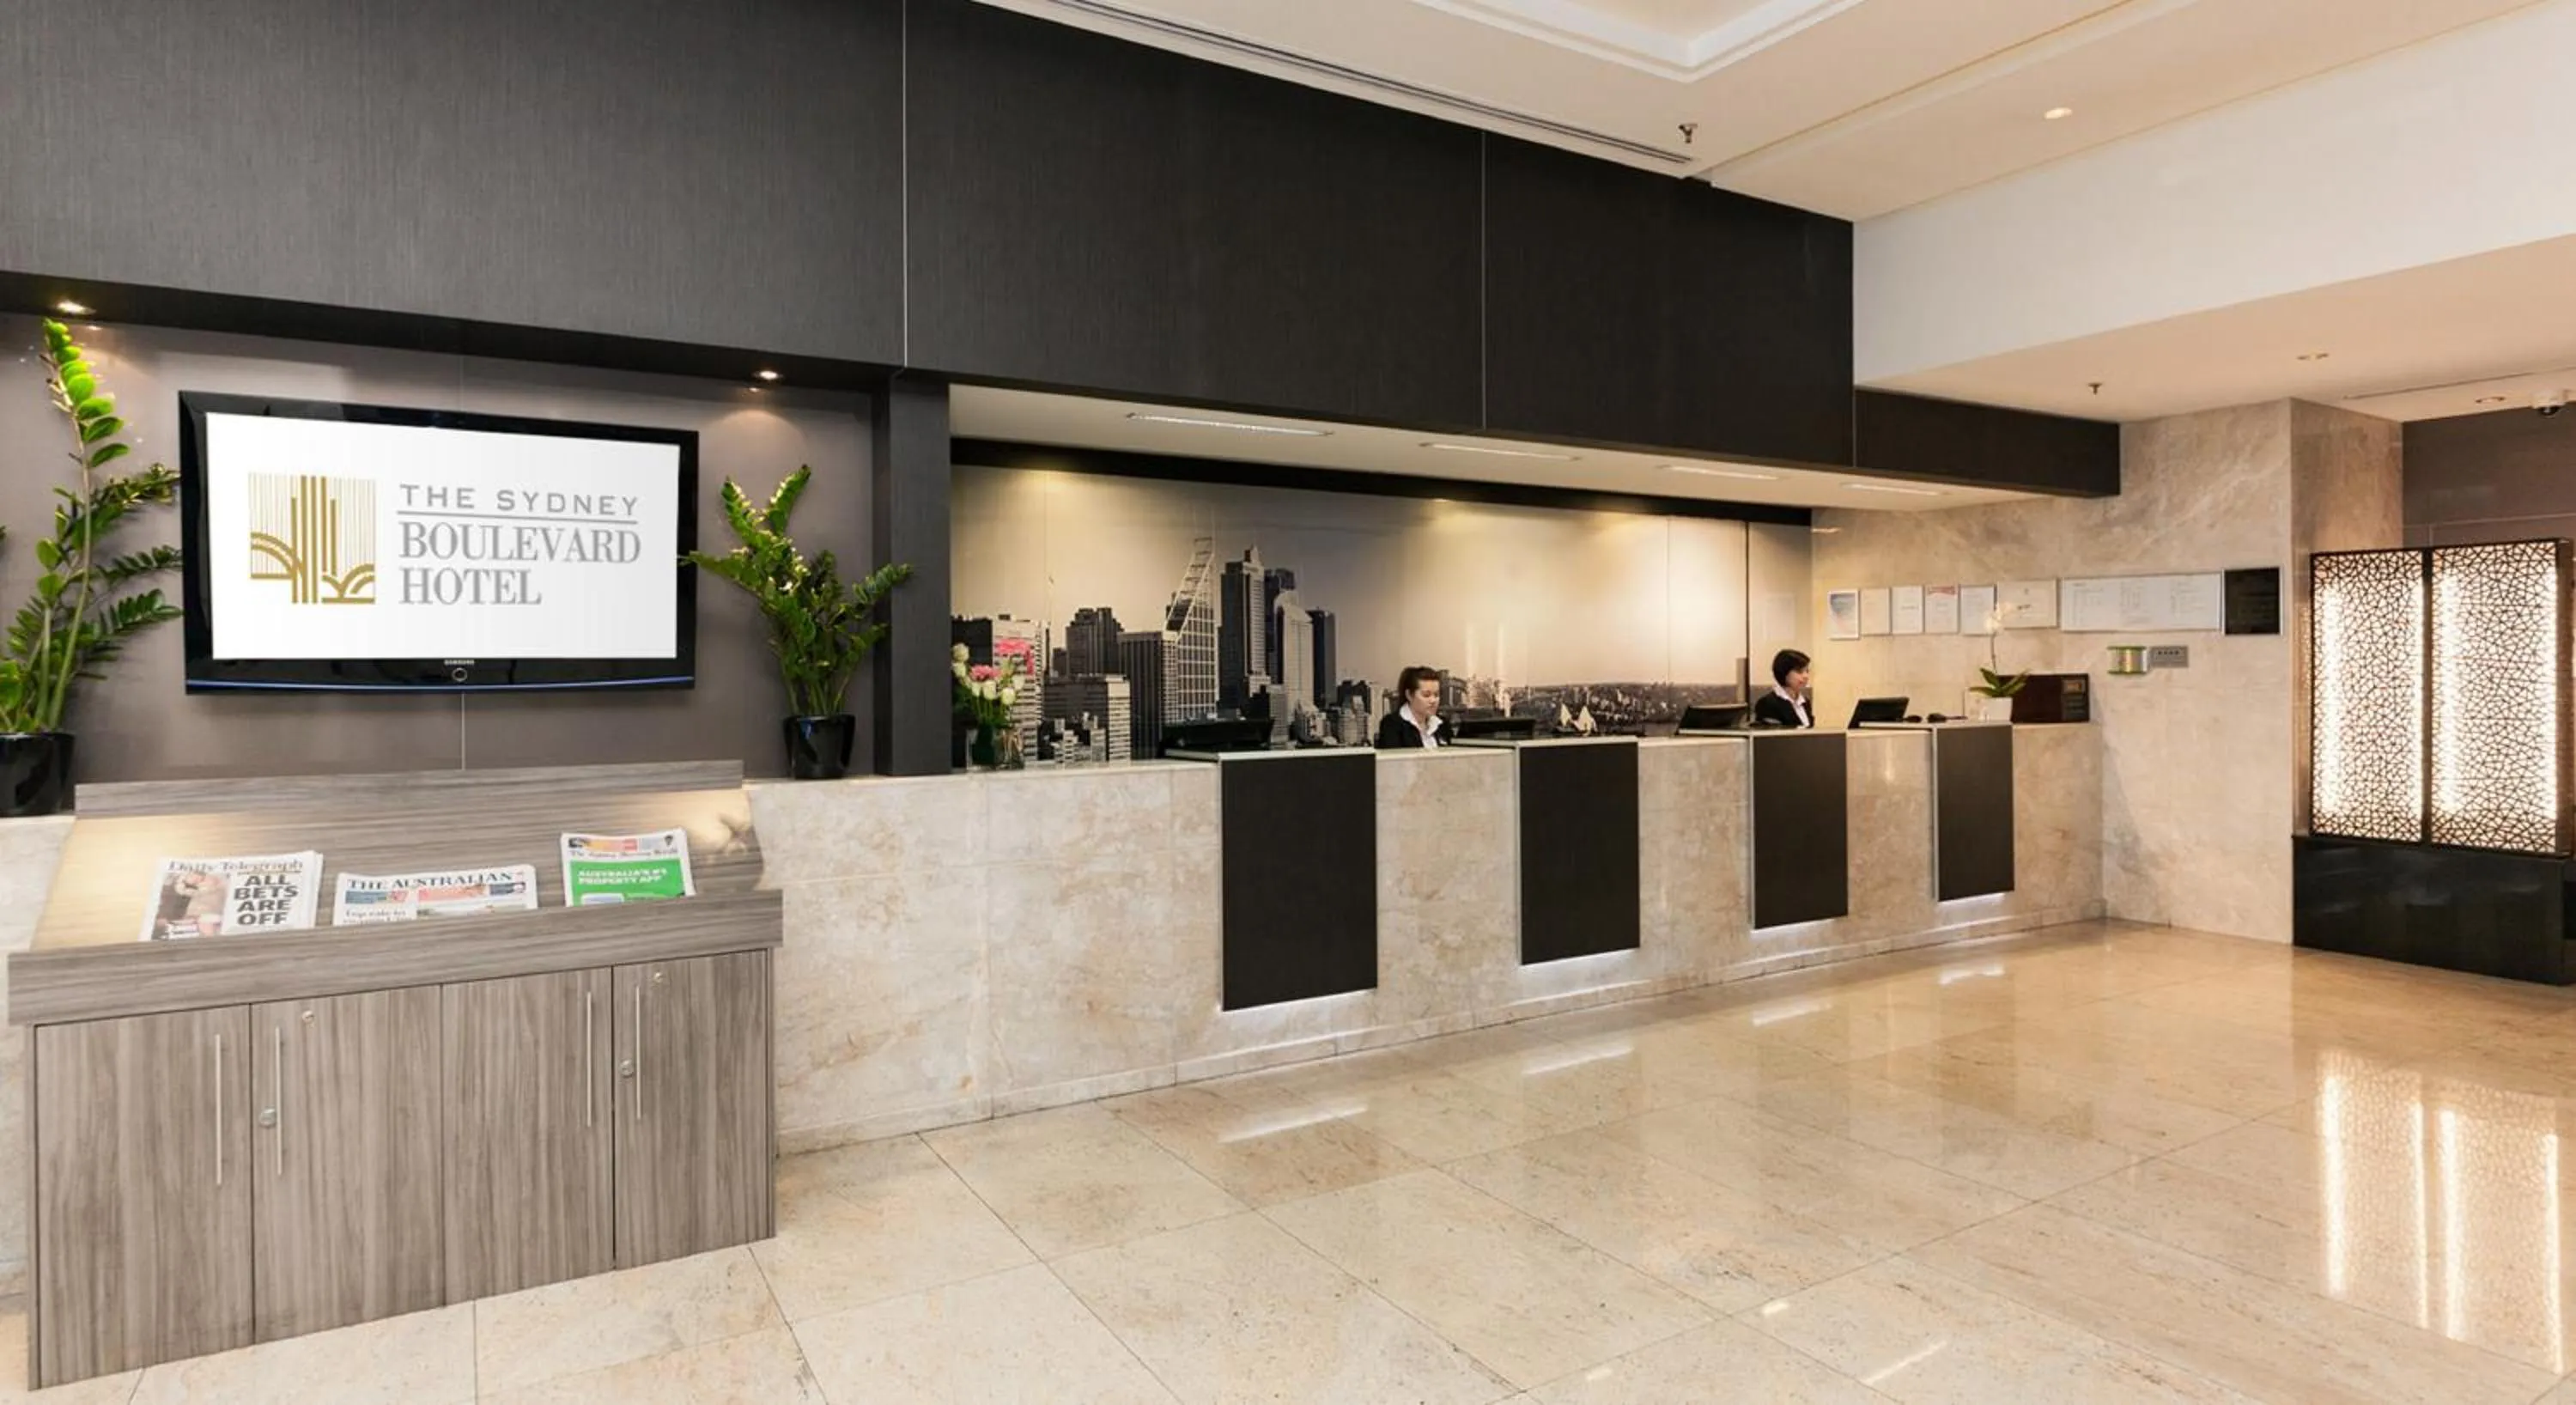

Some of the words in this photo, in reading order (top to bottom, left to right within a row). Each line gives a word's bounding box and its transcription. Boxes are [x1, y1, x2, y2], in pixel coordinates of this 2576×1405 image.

[399, 484, 475, 509] THE
[496, 489, 637, 516] SYDNEY
[398, 521, 641, 564] BOULEVARD
[398, 567, 542, 605] HOTEL
[220, 858, 303, 873] Telegraph
[244, 873, 290, 886] ALL
[346, 879, 387, 890] THE
[392, 872, 513, 888] AUSTRALIAN
[233, 885, 299, 900] BETS
[236, 899, 292, 912] ARE
[237, 911, 289, 925] OFF
